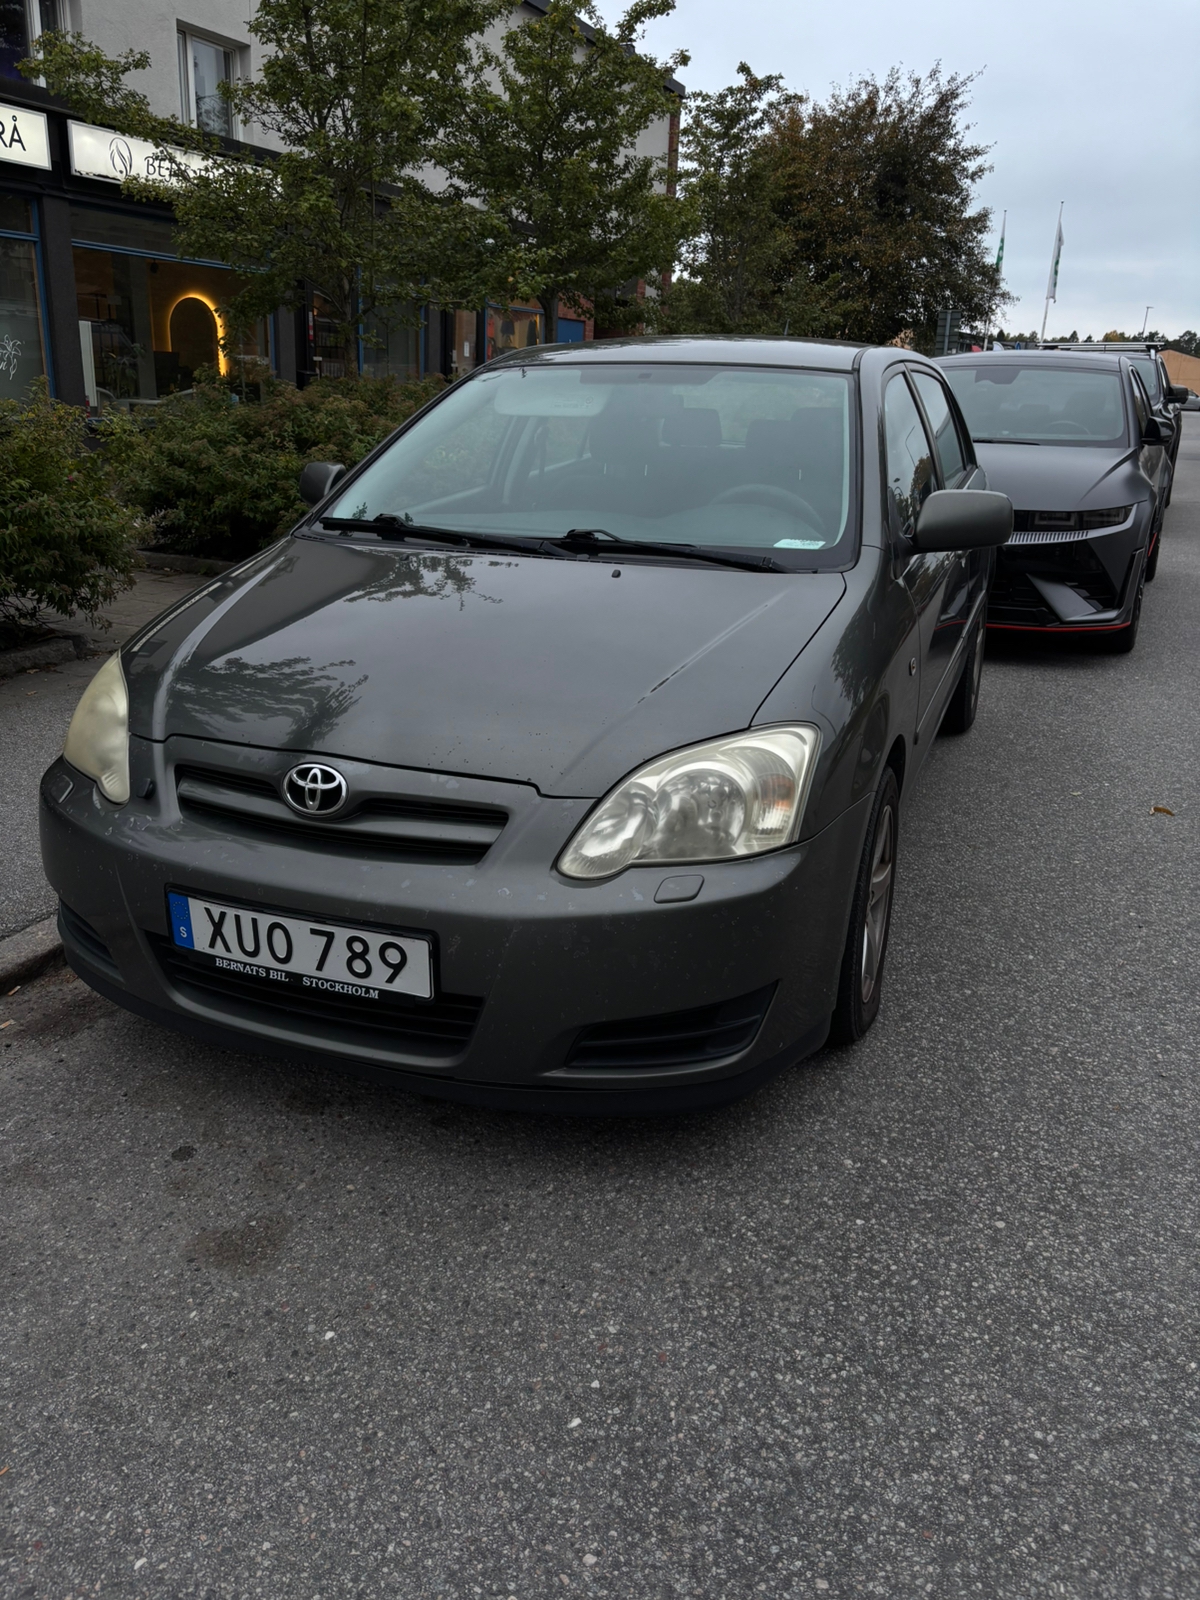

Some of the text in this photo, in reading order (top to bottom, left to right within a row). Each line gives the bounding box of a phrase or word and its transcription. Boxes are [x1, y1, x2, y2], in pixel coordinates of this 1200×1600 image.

[179, 926, 188, 938] S
[204, 906, 408, 984] XUO 789
[215, 957, 380, 999] BERNATS BIL STOCKHOLM
